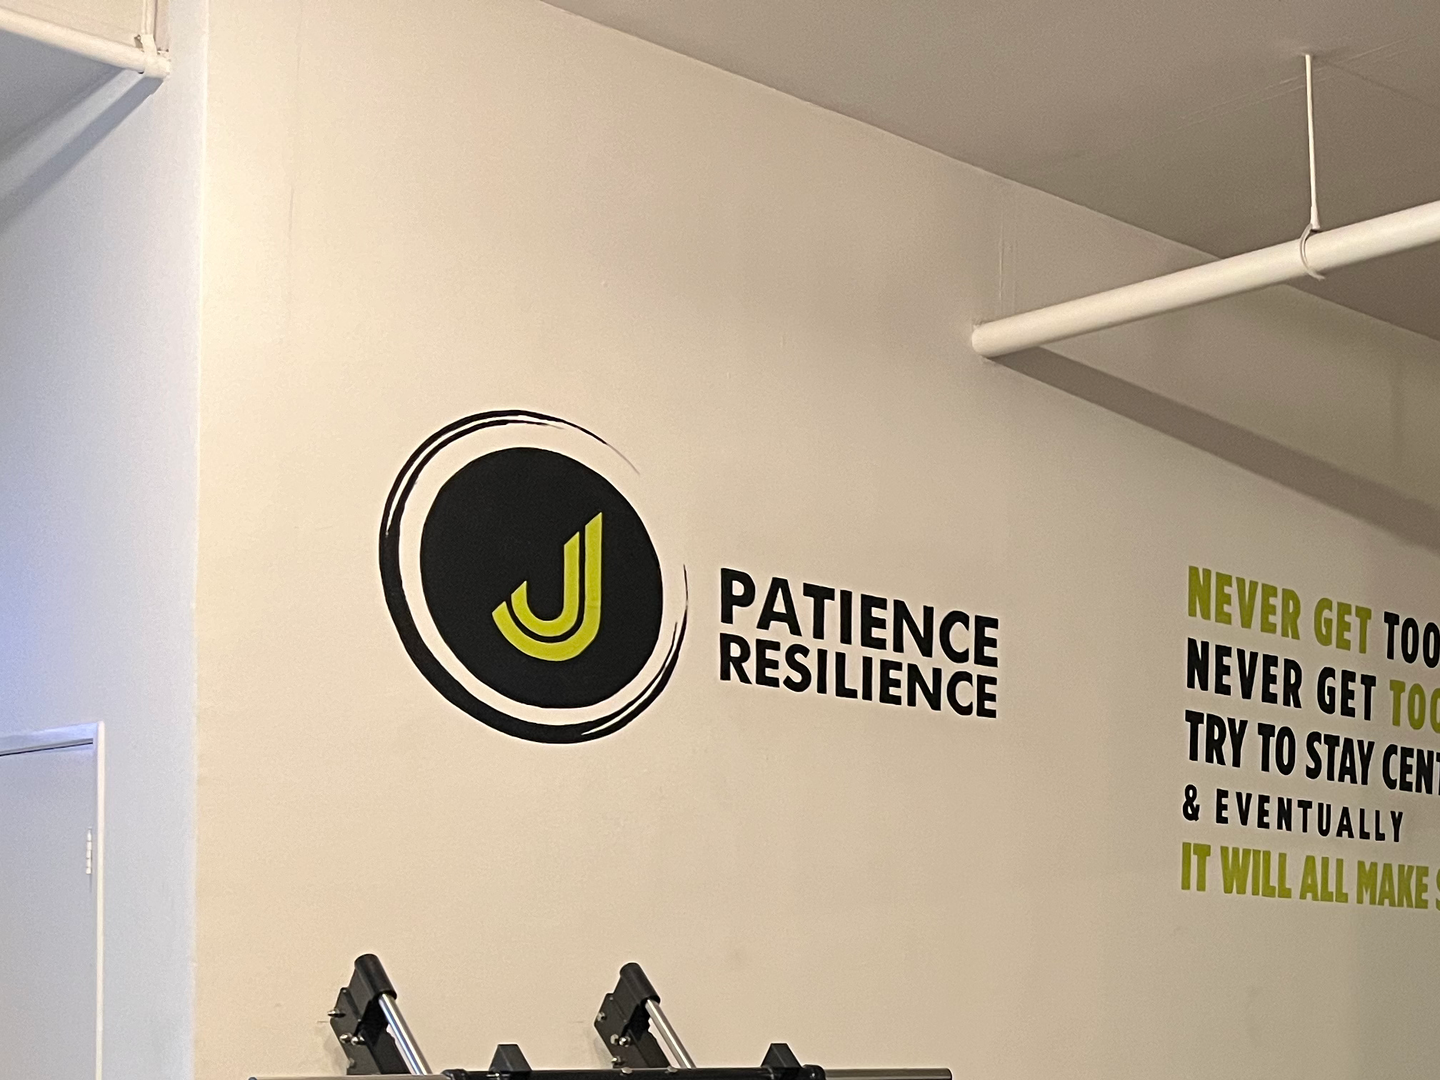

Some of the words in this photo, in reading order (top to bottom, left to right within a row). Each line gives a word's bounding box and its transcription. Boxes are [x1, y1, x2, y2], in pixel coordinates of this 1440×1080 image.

[720, 567, 999, 667] PATIENCE
[1188, 565, 1301, 640] NEVER
[1314, 597, 1372, 654] GET
[1384, 611, 1440, 668] TOO
[719, 633, 997, 718] RESILIENCE
[1186, 637, 1302, 709] NEVER
[1317, 666, 1376, 721] GET
[1185, 709, 1248, 768] TRY
[1257, 722, 1296, 776] TO
[1305, 731, 1375, 785] STAY
[1182, 784, 1200, 821] &
[1215, 788, 1403, 843] EVENTUALLY
[1181, 842, 1211, 892] IT
[1220, 845, 1292, 899] WILL
[1299, 855, 1349, 903] ALL
[1356, 860, 1429, 910] MAKE
